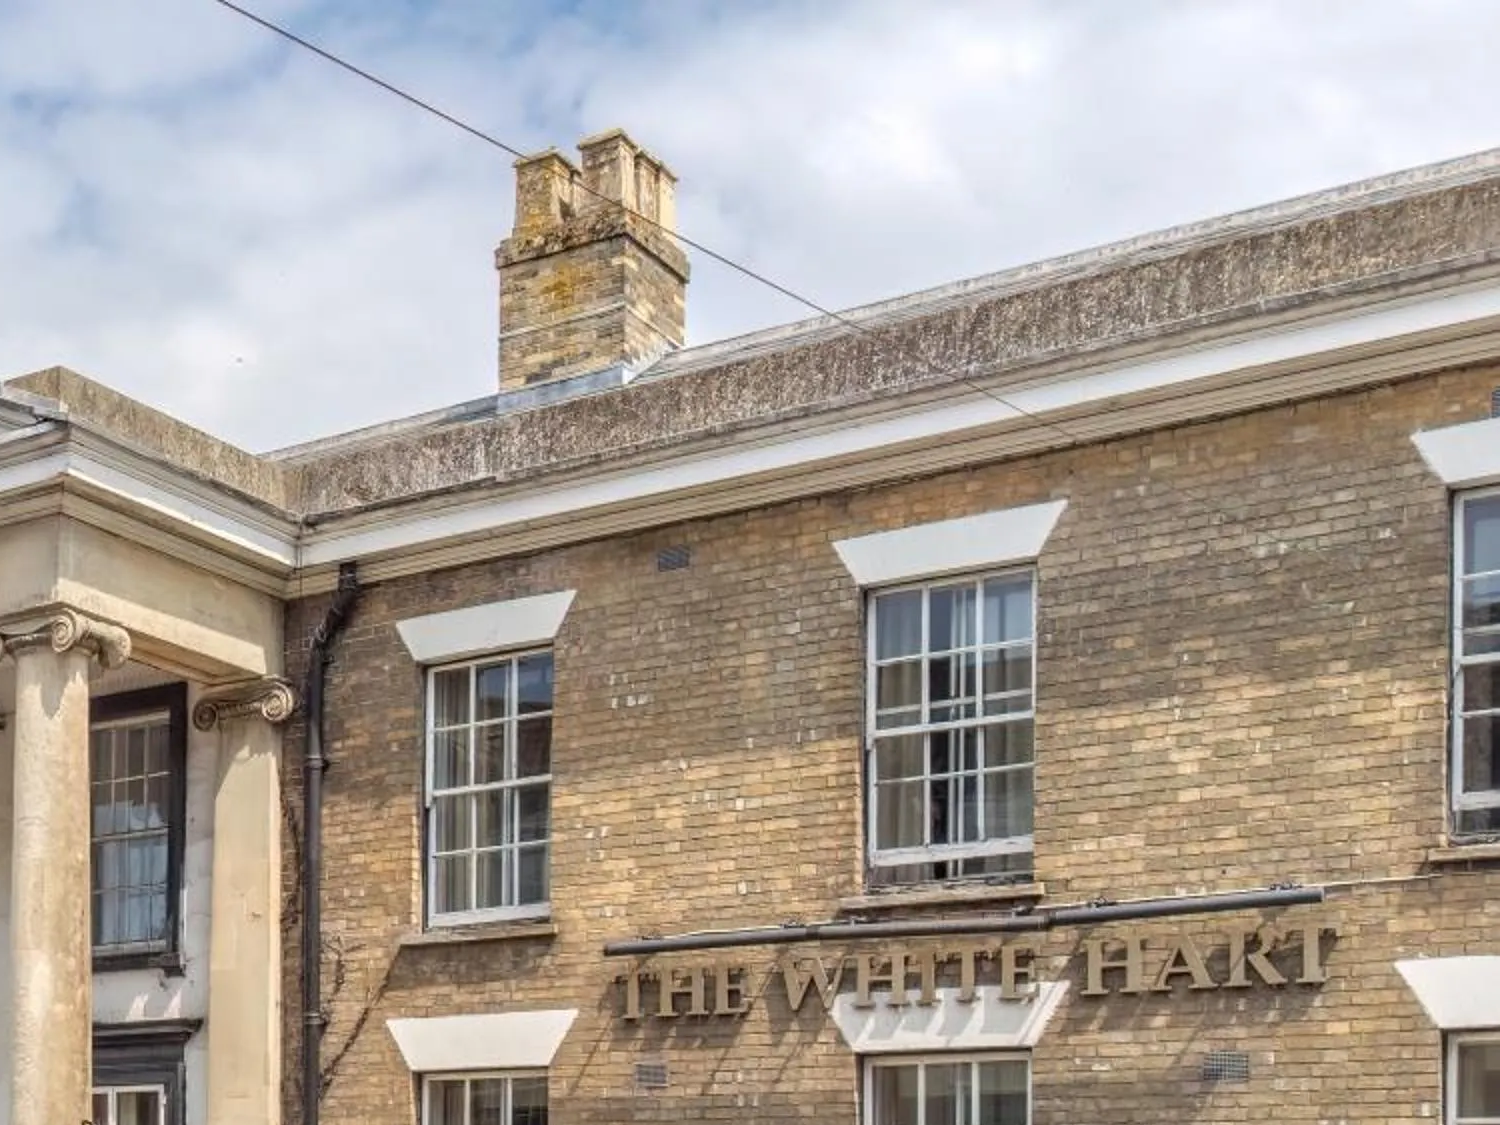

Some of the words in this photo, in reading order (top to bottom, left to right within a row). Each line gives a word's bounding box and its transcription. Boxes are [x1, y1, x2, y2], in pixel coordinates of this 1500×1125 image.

[616, 965, 749, 1020] THE
[777, 944, 1041, 1011] WHITE
[1080, 926, 1340, 996] HART
